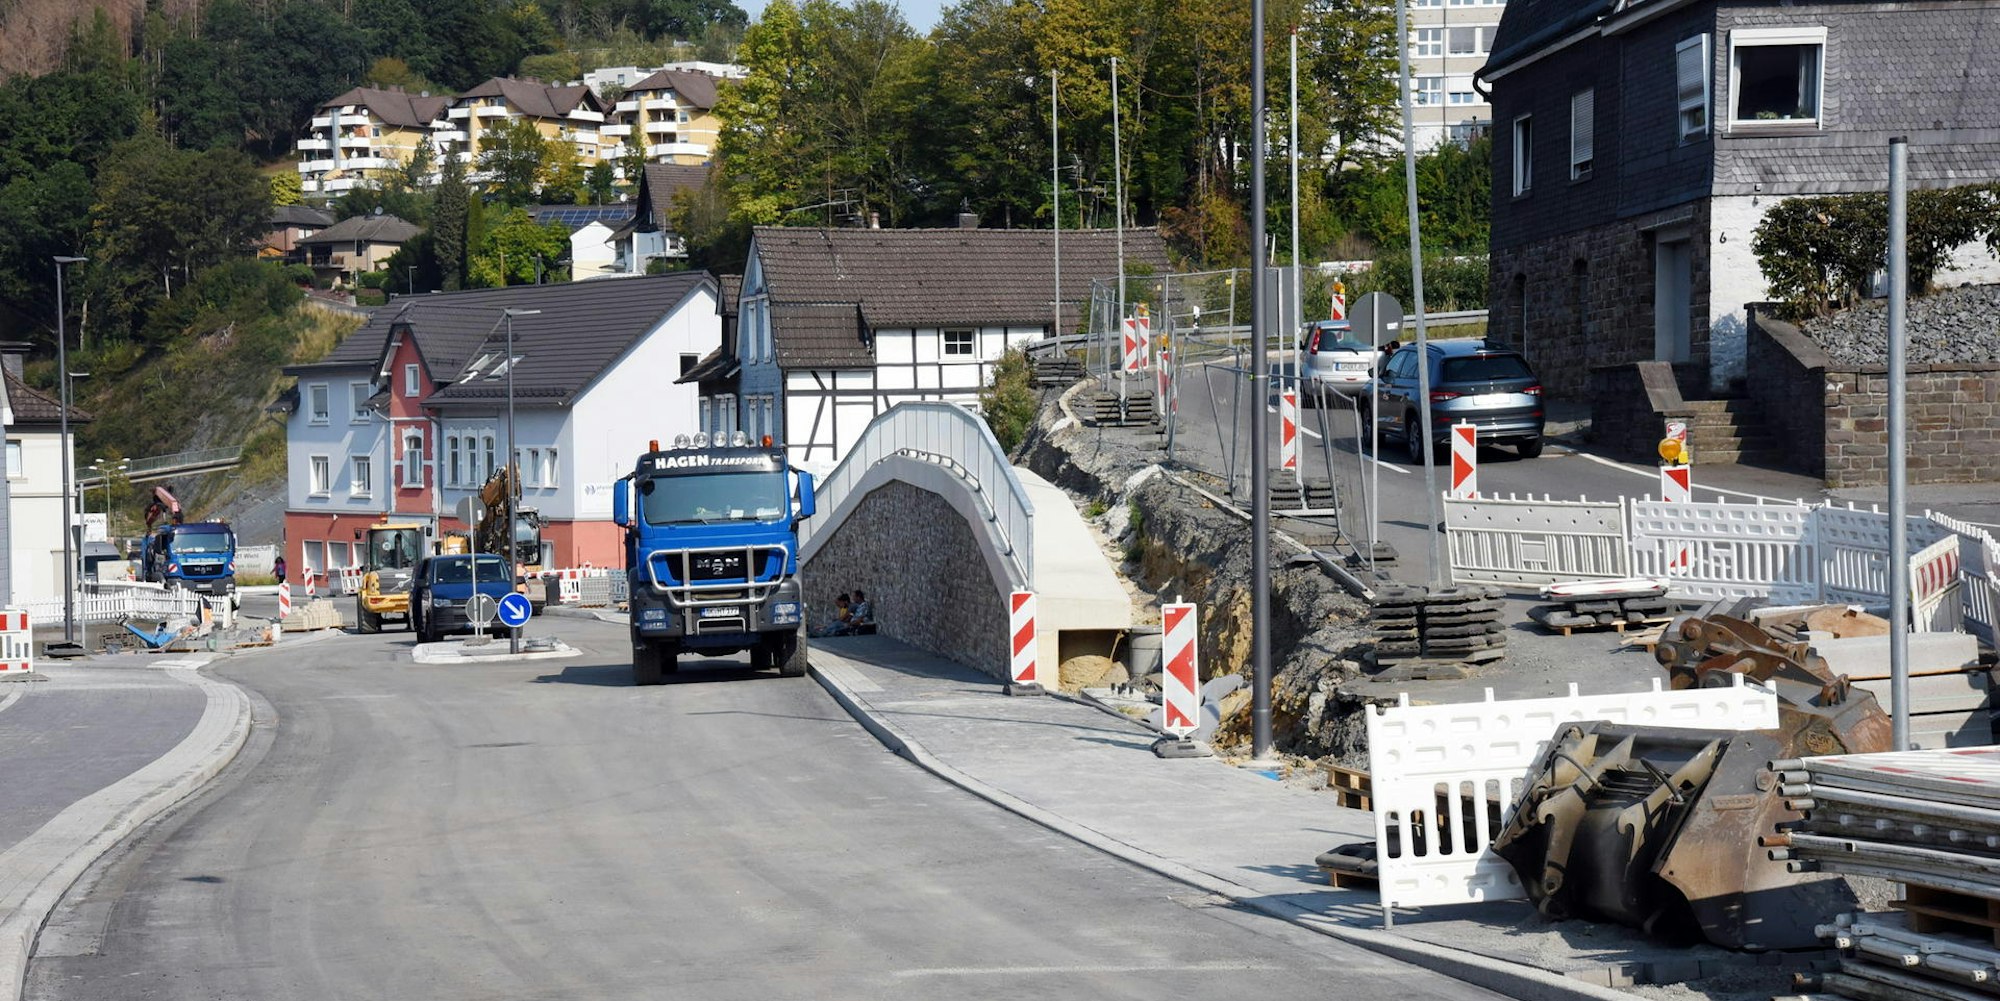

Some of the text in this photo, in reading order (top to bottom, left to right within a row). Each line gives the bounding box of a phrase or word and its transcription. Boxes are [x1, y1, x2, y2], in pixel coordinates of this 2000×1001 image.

[1719, 231, 1727, 244] 6
[655, 454, 771, 470] HAGEN TRANSPORT
[697, 557, 739, 568] MAN
